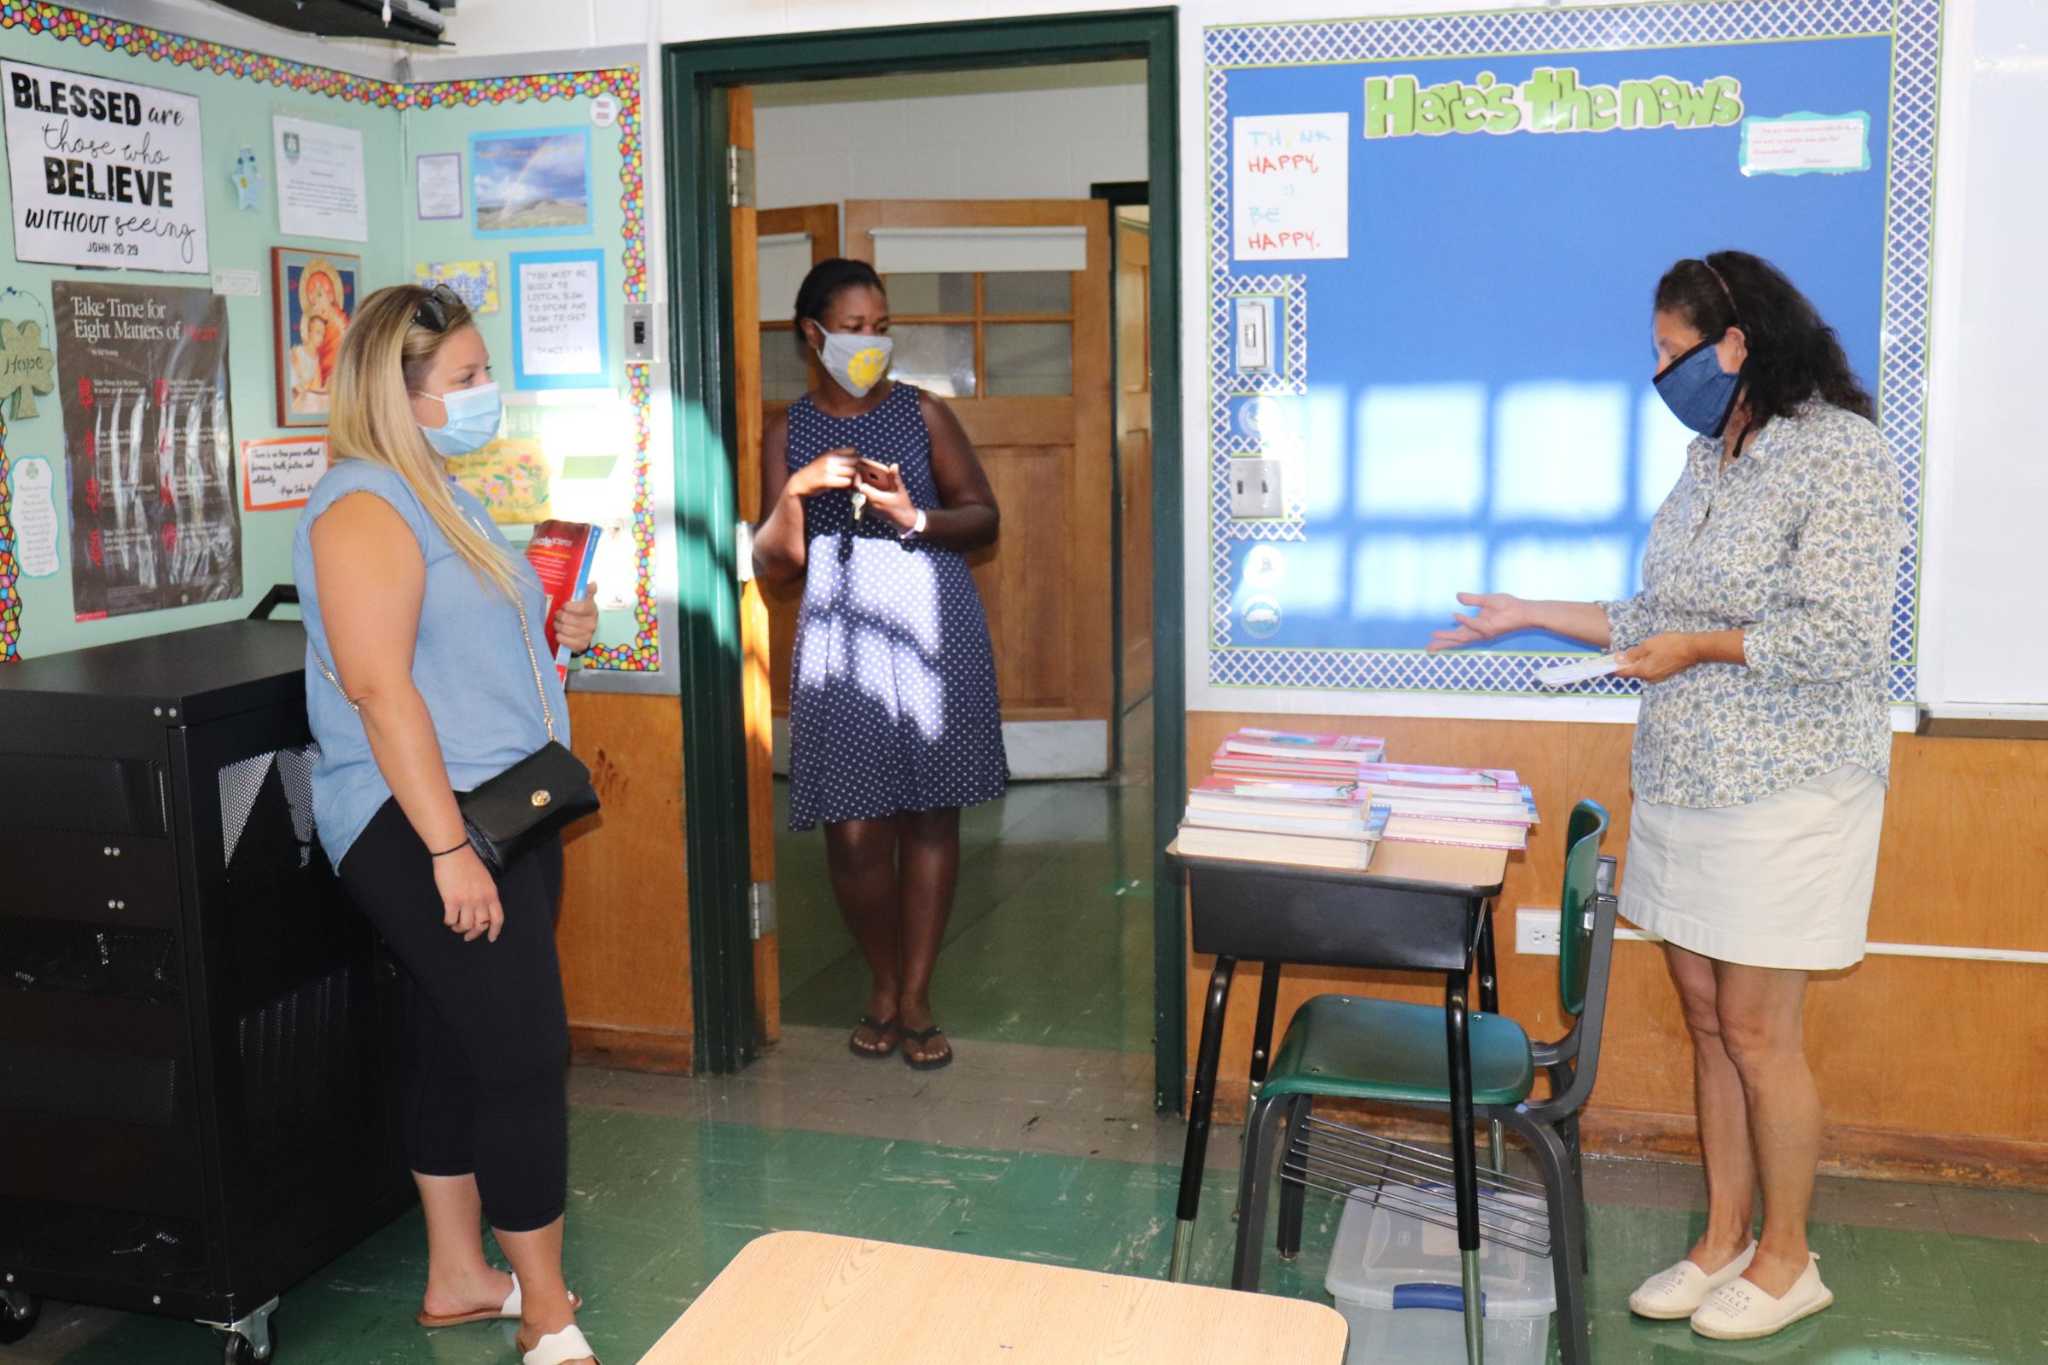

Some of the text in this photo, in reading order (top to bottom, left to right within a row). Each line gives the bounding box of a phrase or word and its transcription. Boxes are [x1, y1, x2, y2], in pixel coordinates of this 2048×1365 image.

[11, 72, 184, 127] BLESSED are
[1364, 67, 1744, 138] Here's the news
[42, 119, 169, 165] those who
[44, 156, 174, 208] BELIEVE
[25, 208, 196, 264] WITHOUT seeing
[87, 242, 111, 254] JOHN
[70, 296, 166, 319] Take Time for
[73, 318, 111, 344] Eight
[114, 320, 163, 340] Matters
[166, 321, 181, 340] of
[4, 354, 44, 376] Hope
